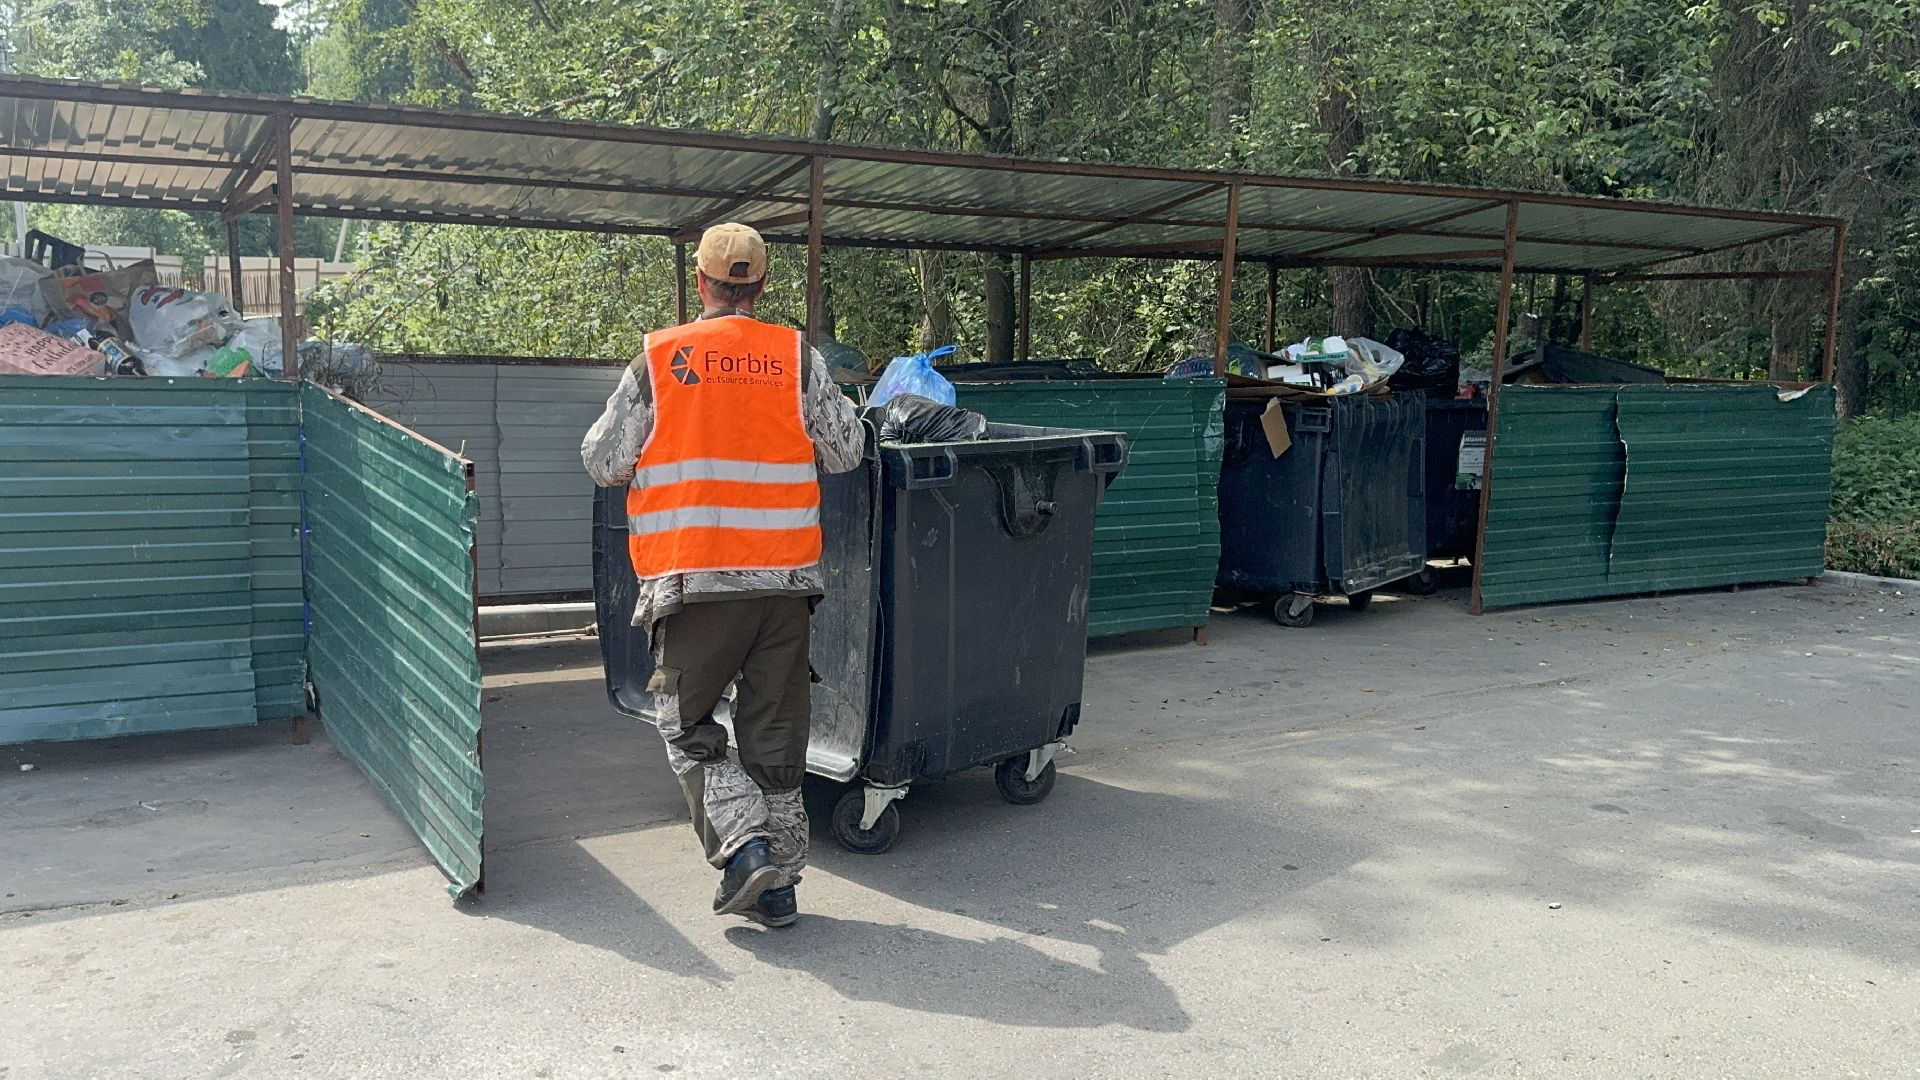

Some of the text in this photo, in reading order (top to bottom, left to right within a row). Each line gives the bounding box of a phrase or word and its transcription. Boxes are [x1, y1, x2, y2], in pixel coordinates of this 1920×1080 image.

[705, 351, 783, 375] Forbis
[706, 376, 784, 387] outsource services
